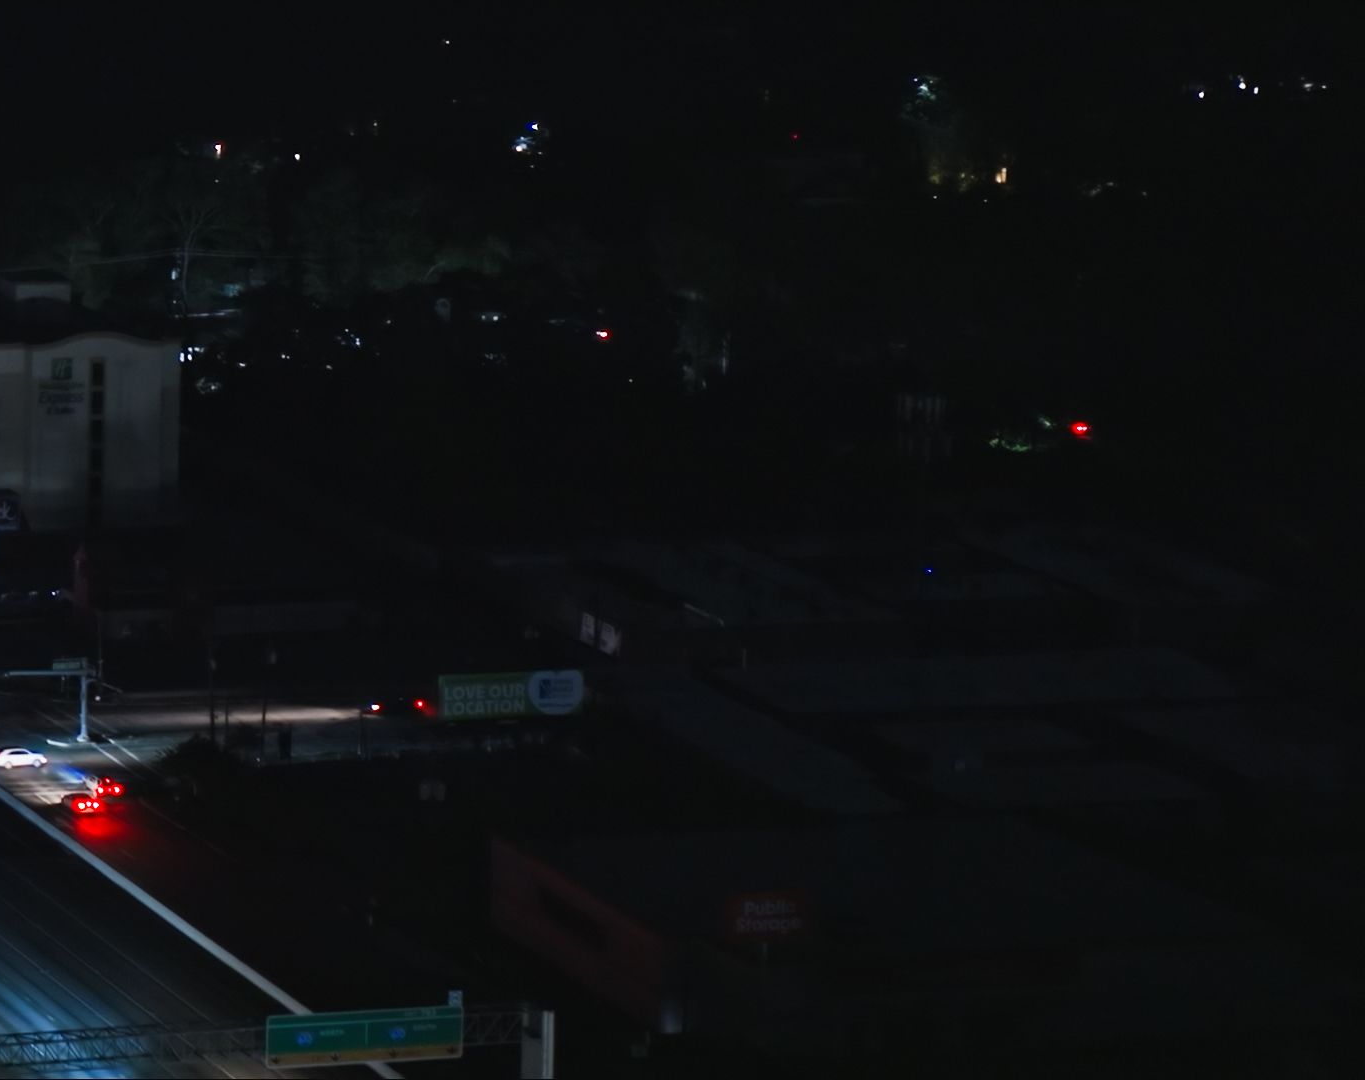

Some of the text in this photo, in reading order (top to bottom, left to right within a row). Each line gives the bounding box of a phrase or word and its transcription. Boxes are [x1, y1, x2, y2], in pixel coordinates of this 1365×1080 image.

[444, 683, 525, 701] LOVE OUR
[444, 699, 525, 716] LOCATION
[744, 901, 796, 915] Public
[735, 918, 802, 934] Storage
